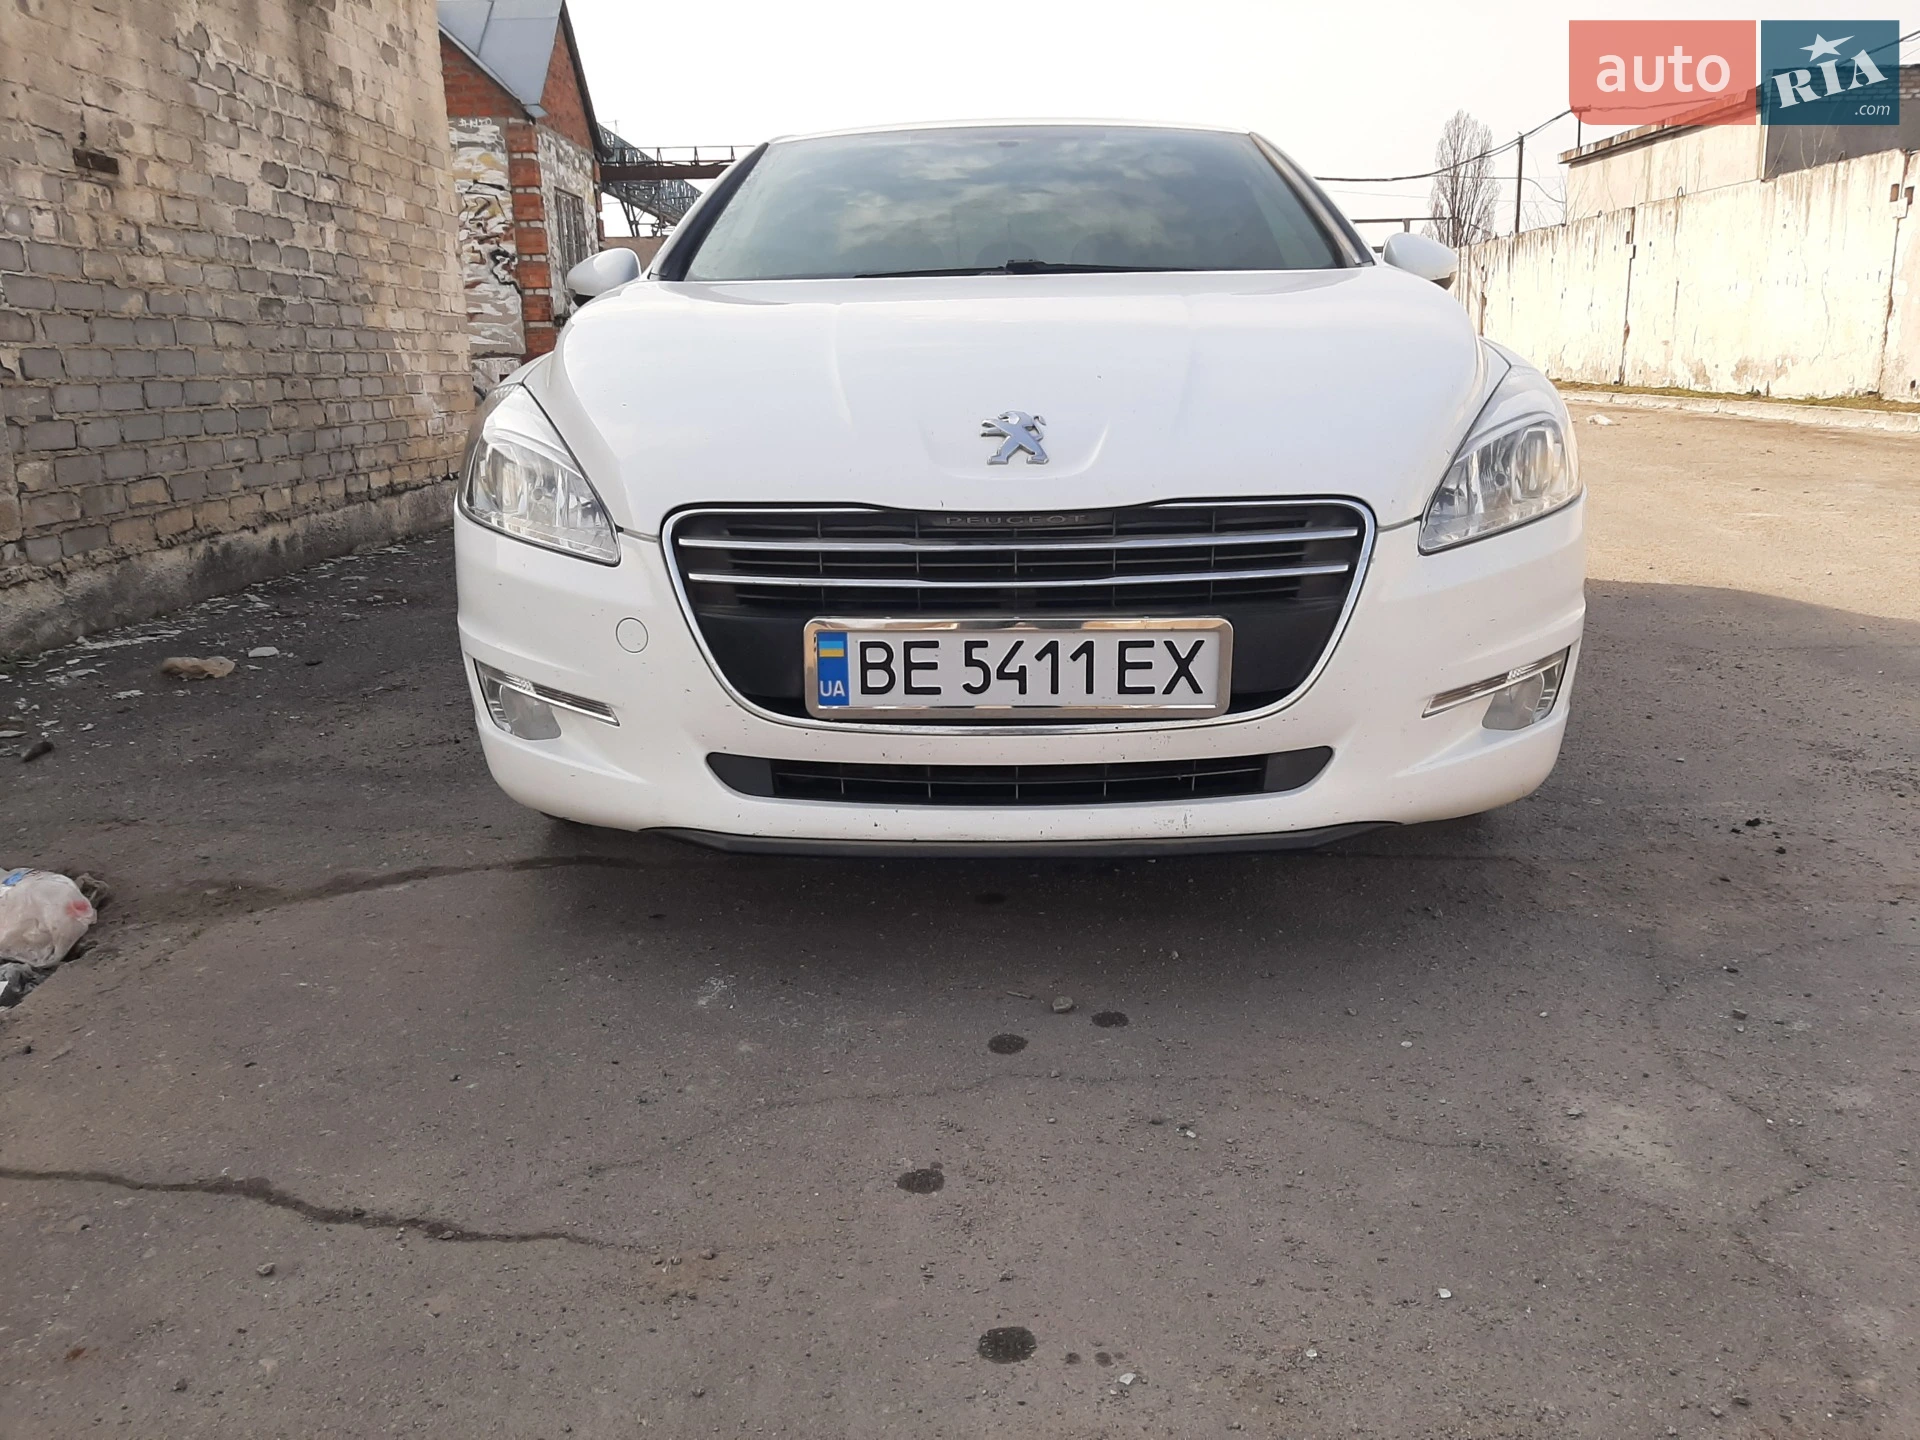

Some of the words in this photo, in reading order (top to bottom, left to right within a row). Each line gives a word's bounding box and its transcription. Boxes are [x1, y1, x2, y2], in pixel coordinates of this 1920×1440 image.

[945, 514, 1087, 525] PEUGEOT
[859, 640, 942, 696] BE
[962, 640, 1095, 696] 5411
[1117, 639, 1205, 696] EX
[819, 680, 846, 697] UA
